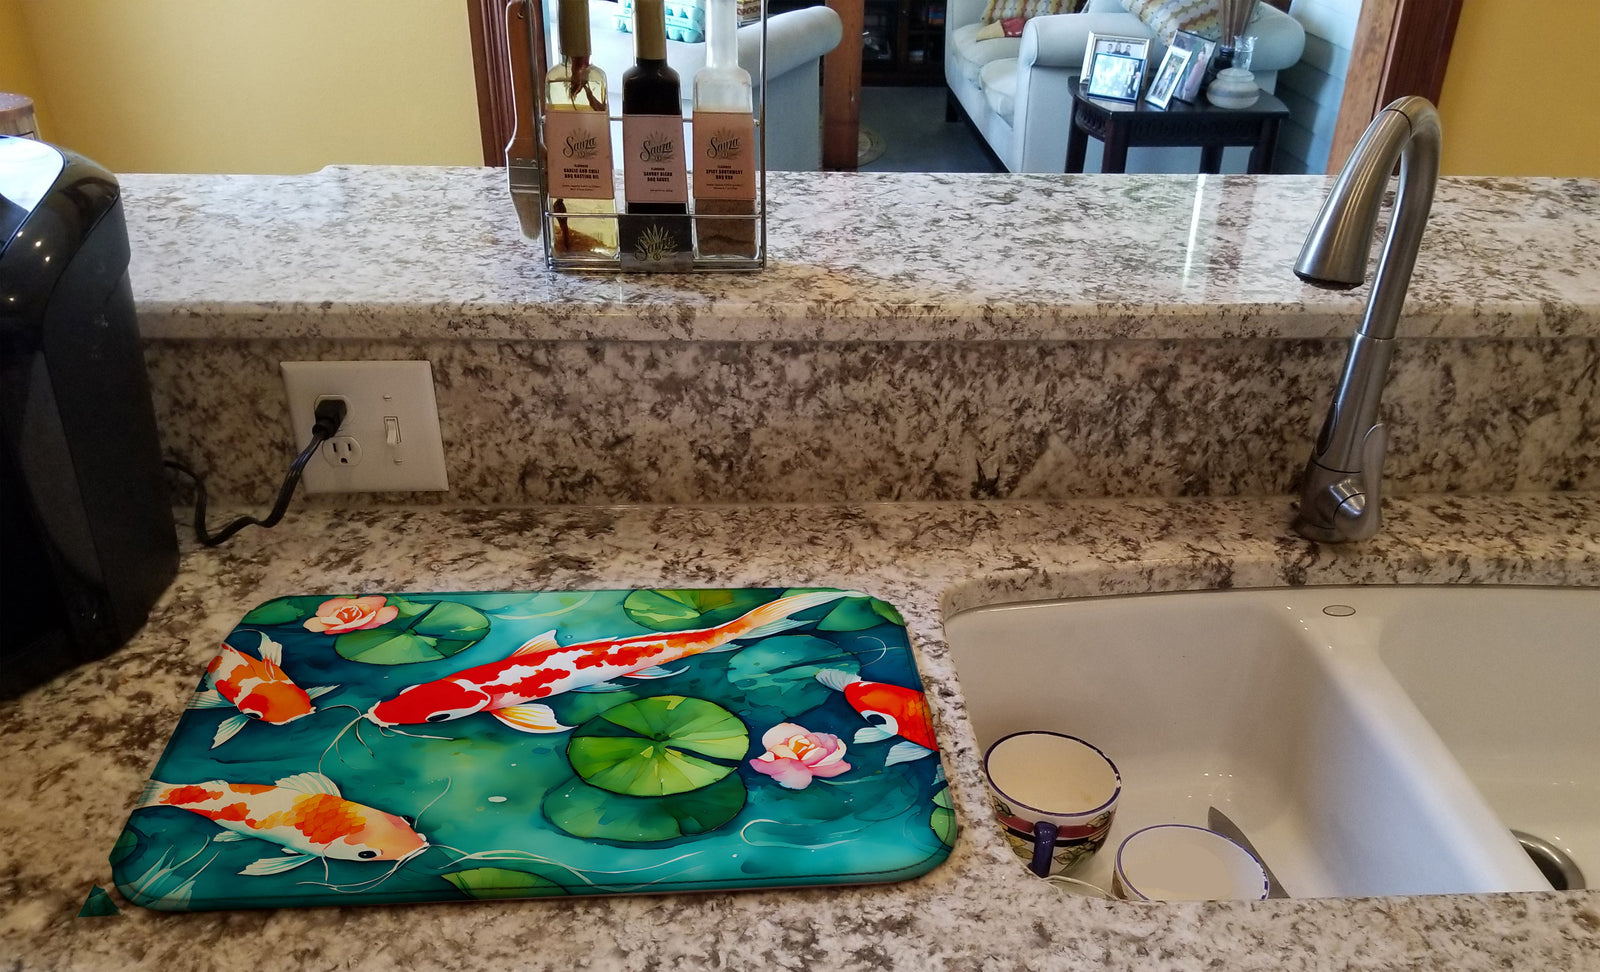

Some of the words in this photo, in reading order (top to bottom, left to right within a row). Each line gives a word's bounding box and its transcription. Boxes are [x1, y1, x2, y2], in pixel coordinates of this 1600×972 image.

[562, 136, 597, 158] Sauza
[640, 140, 674, 161] Sauza
[707, 137, 740, 159] Sauza
